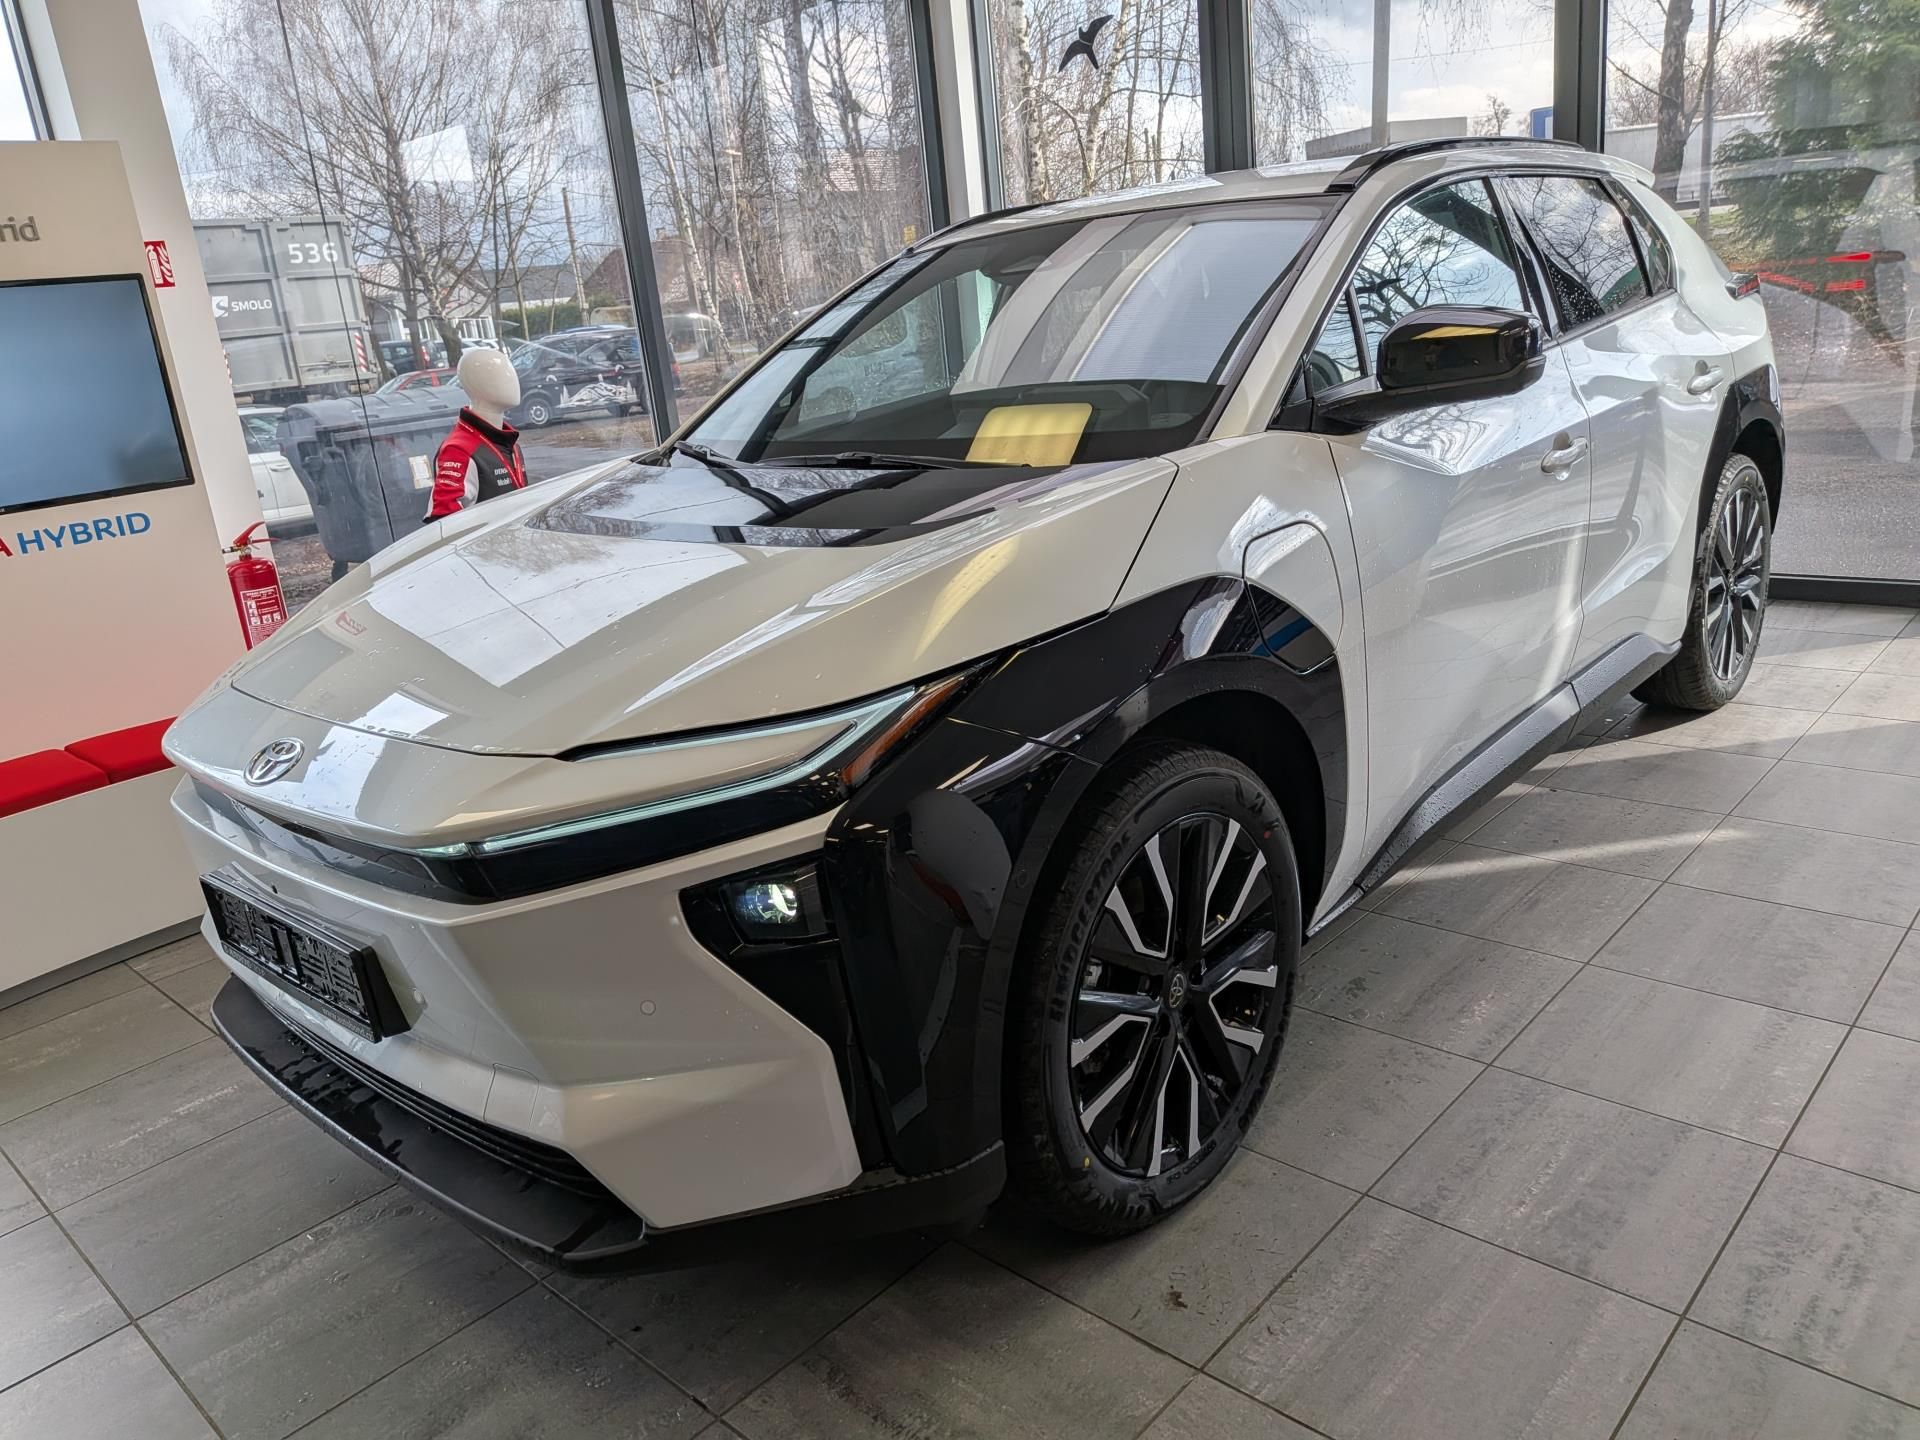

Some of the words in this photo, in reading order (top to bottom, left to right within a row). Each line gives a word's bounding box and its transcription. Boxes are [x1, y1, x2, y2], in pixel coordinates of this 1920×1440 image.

[288, 242, 339, 264] 536
[231, 299, 273, 312] SMOLO
[16, 512, 151, 555] HYBRID
